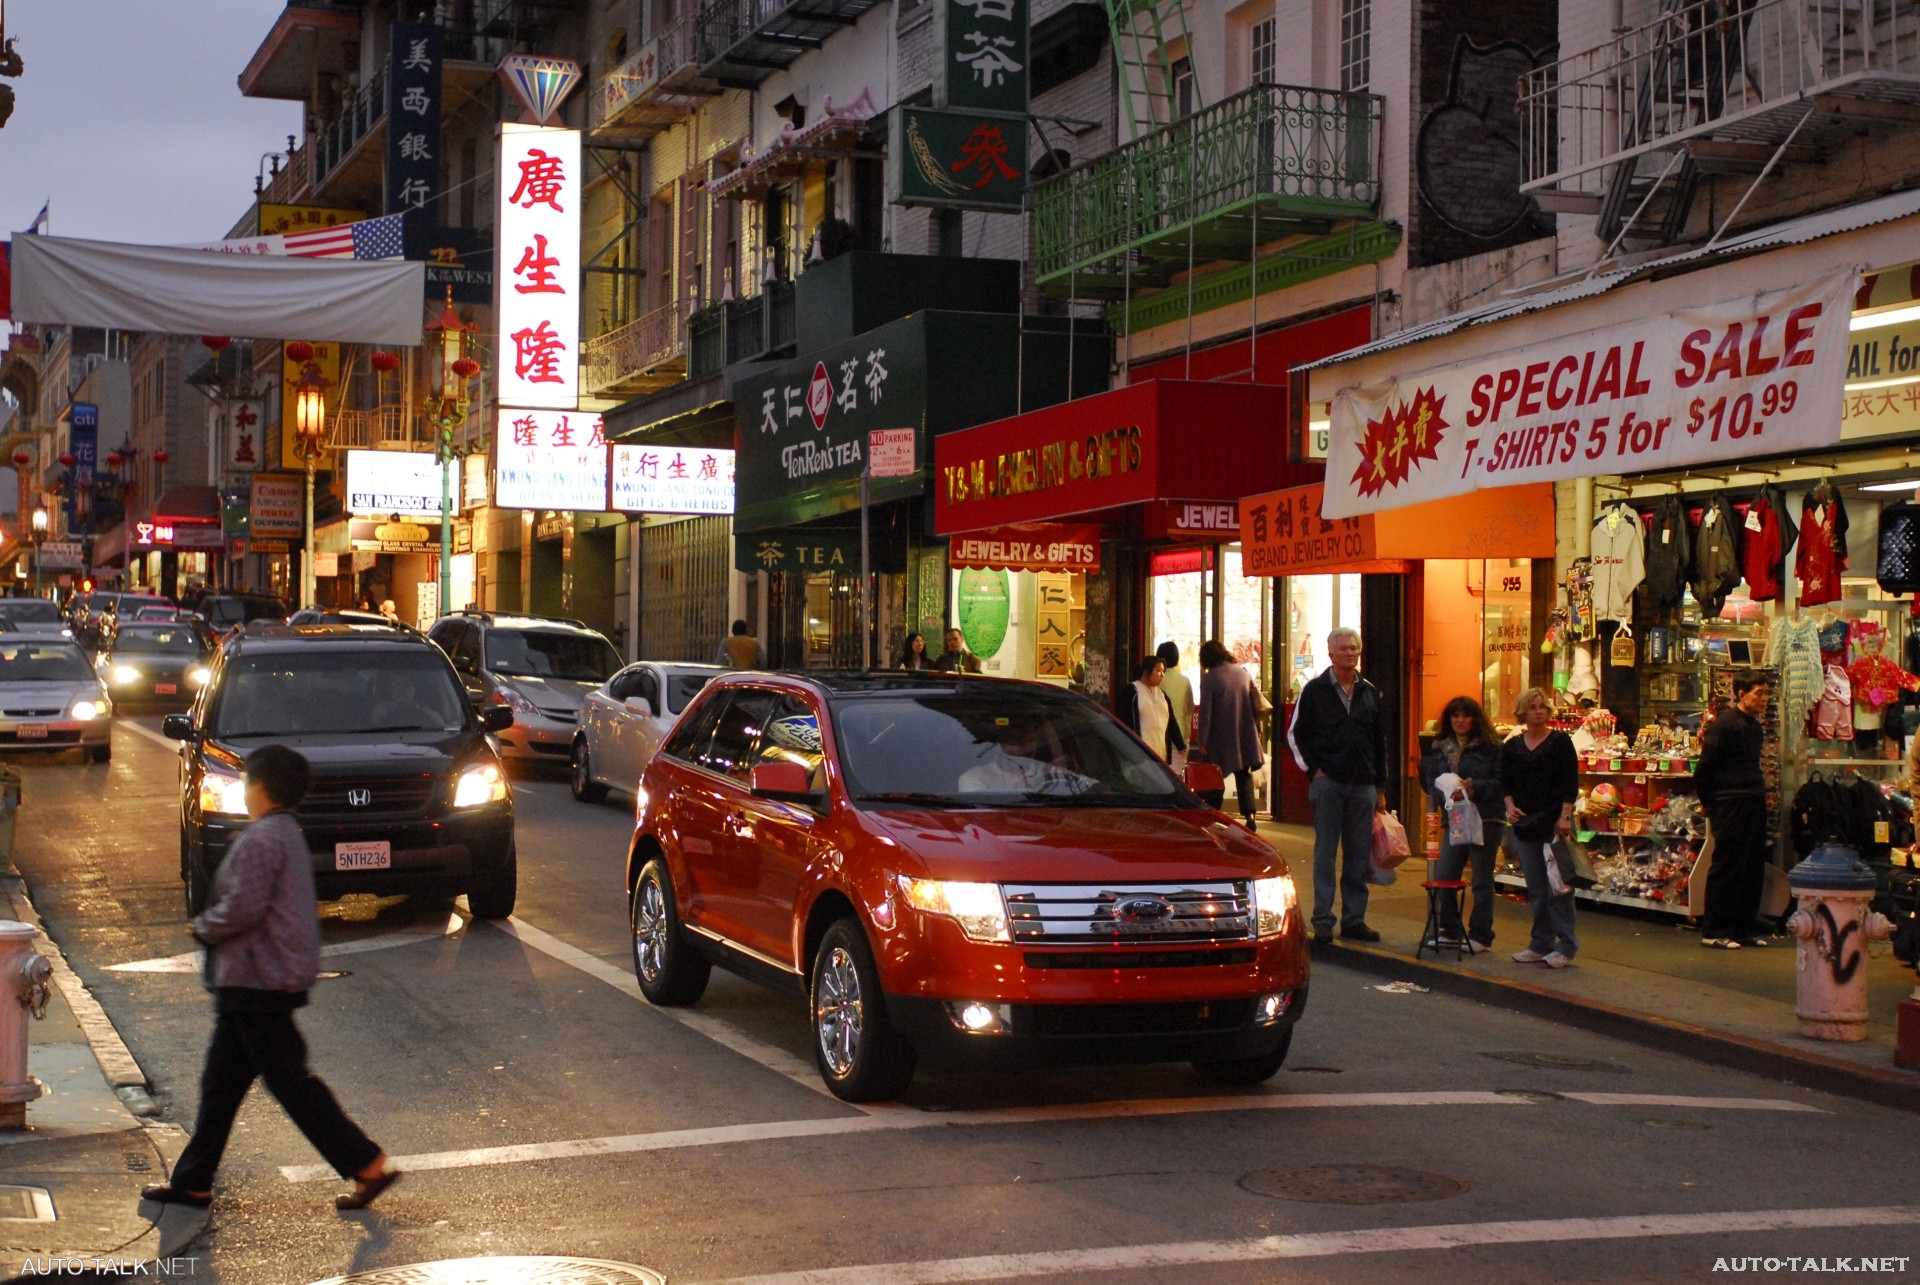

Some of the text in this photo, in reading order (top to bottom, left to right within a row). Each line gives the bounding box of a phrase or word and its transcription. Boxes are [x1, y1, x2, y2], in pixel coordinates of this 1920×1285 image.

[398, 38, 433, 208] 美西銀行
[509, 148, 566, 385] 廣生隆
[453, 270, 493, 284] WEST
[1465, 302, 1823, 428] SPECIAL SALE
[1847, 341, 1880, 379] AIL
[1842, 384, 1920, 421] 衣大平
[74, 415, 95, 426] citi
[1585, 417, 1610, 460] 5
[1617, 411, 1672, 456] for
[1686, 380, 1798, 443] $10.99
[871, 432, 913, 446] NO PARKING
[835, 439, 862, 467] TEA
[956, 467, 968, 502] &
[970, 459, 985, 501] M
[989, 440, 1066, 497] JEWELRY
[1070, 440, 1083, 480] &
[1086, 425, 1142, 480] GIFTS
[258, 485, 299, 496] Canon
[354, 494, 443, 510] SAN FRANCISCO GIFT
[626, 496, 728, 511] GIFTS & HERBS
[254, 518, 300, 527] OLYMPUS
[260, 508, 295, 518] PENTAX
[1176, 505, 1240, 530] JEWEL
[381, 530, 424, 540] GALLERY
[756, 541, 785, 568] 茶
[796, 547, 844, 564] TEA
[956, 540, 1094, 563] JEWELRY & GIFTS
[1251, 533, 1365, 570] GRAND JEWELRY CO.
[1502, 577, 1522, 592] 955
[340, 852, 387, 866] 5NTH236
